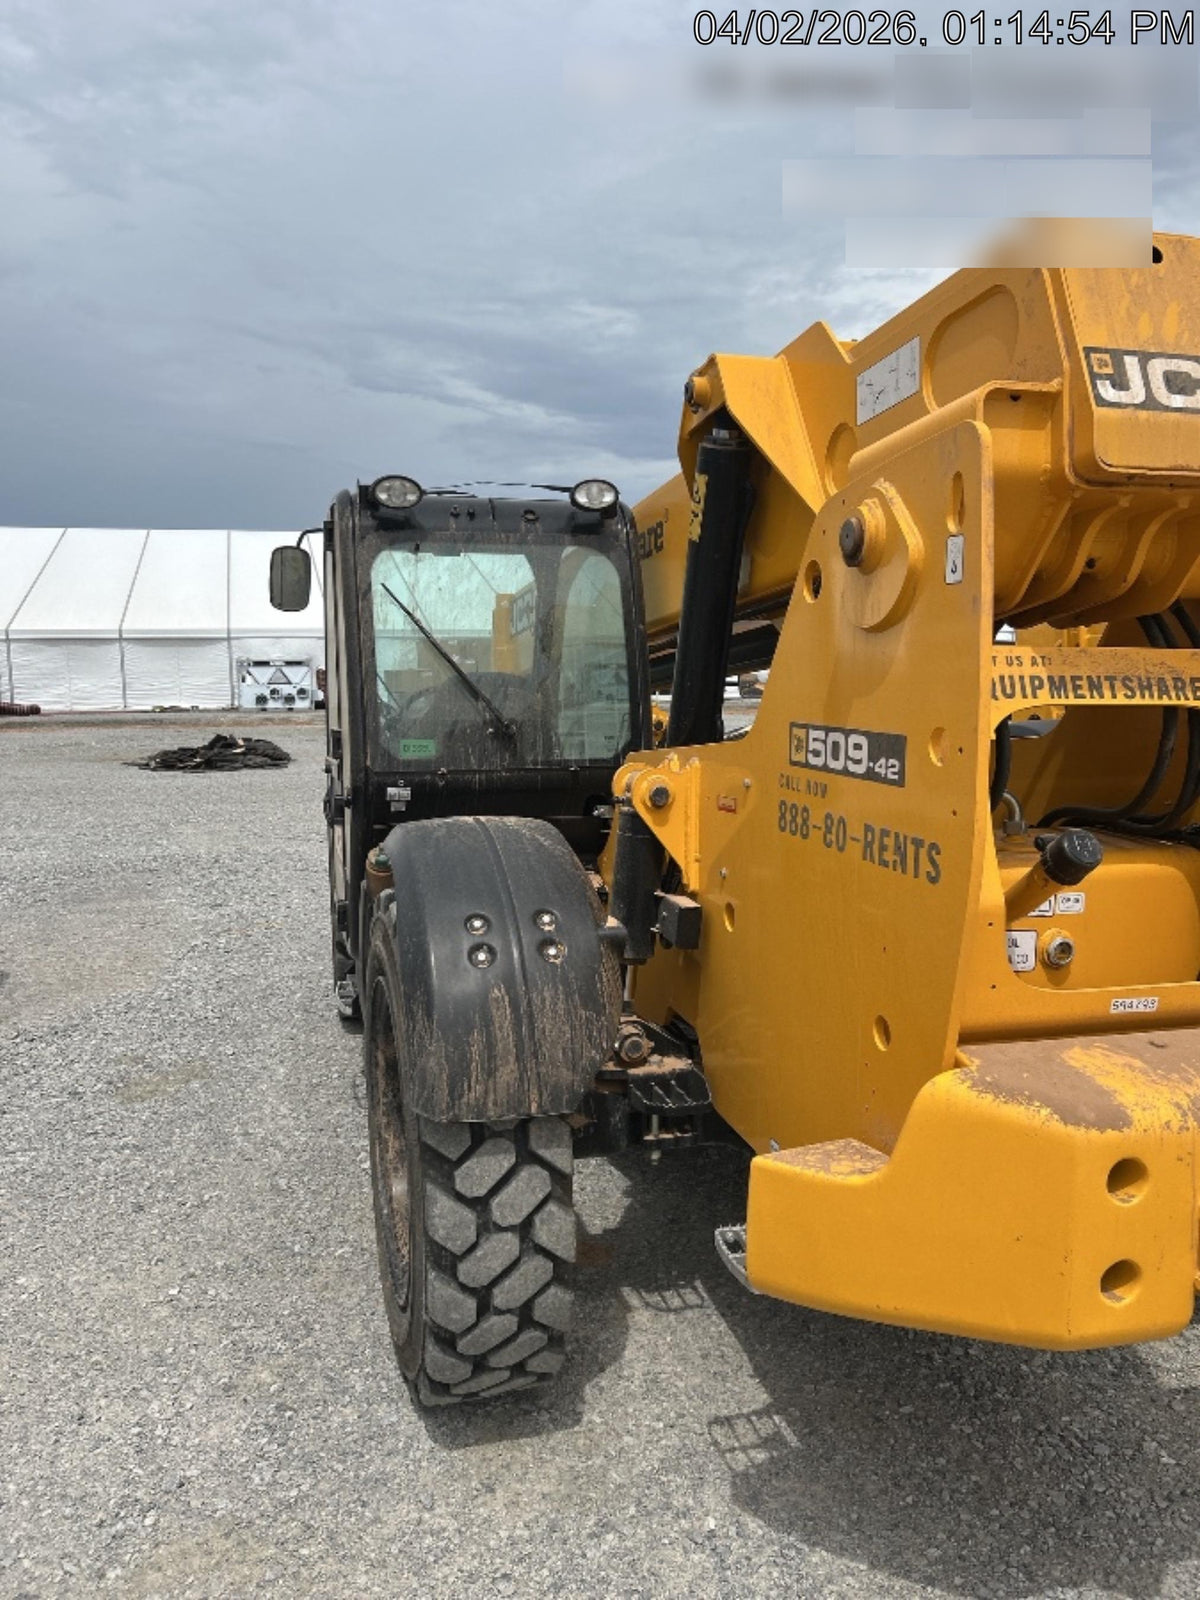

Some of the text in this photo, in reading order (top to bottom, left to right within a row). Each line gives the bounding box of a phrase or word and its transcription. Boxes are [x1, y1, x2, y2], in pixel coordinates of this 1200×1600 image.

[1005, 655, 1023, 667] US
[778, 773, 828, 799] CALL NOW
[778, 799, 942, 886] 888-80-RENTS
